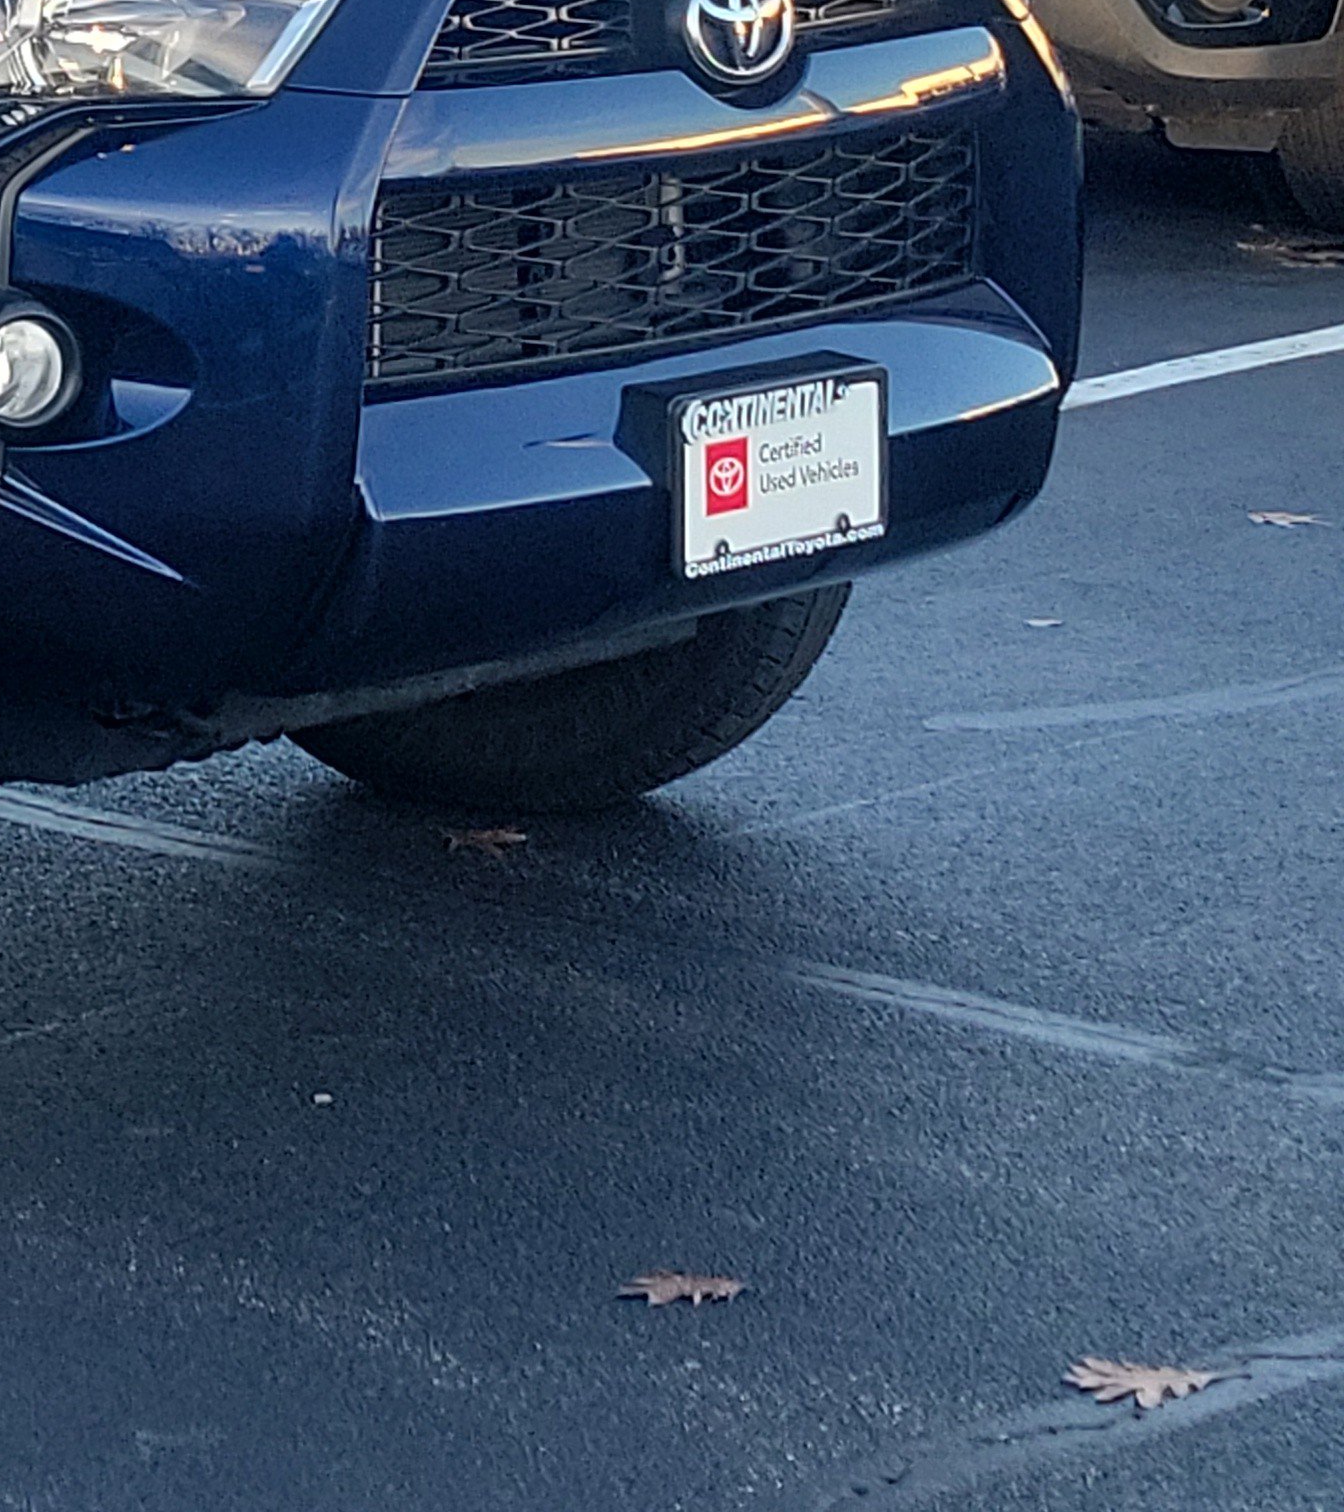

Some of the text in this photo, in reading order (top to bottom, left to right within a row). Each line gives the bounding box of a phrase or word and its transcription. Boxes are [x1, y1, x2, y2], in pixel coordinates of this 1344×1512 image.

[685, 380, 836, 440] CONTINENTAL
[759, 433, 822, 463] Certified
[759, 458, 860, 494] Used Vehicles
[685, 524, 885, 579] ContinentalToyota.com
